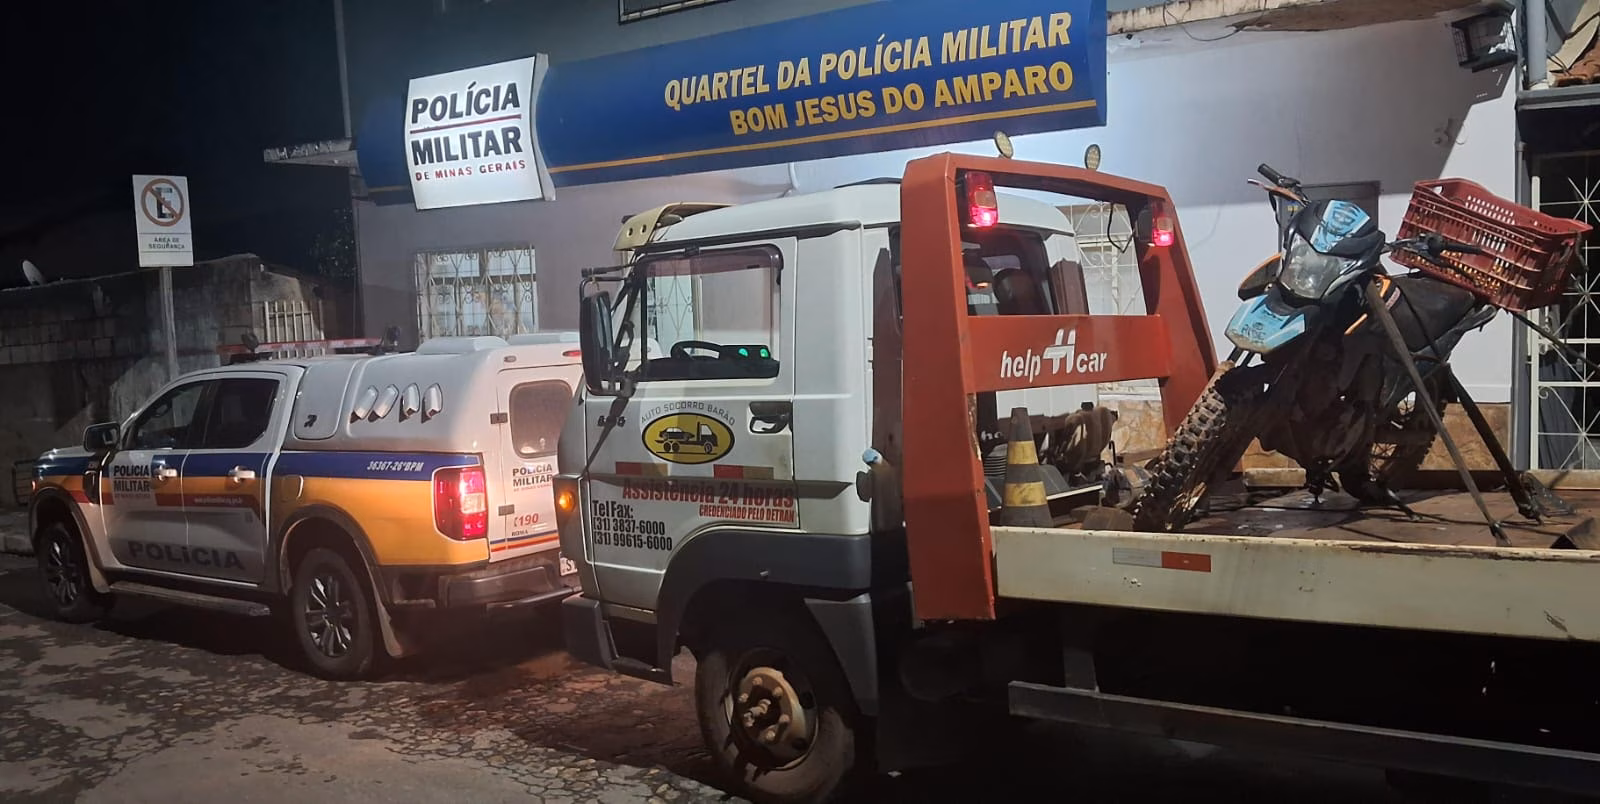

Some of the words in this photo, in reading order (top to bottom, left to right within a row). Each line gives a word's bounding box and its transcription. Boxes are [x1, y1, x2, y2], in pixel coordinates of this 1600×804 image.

[664, 64, 770, 110] QUARTEL
[777, 57, 811, 90] DA
[819, 33, 931, 84] POLÍCIA
[941, 11, 1072, 64] MILITAR
[411, 81, 520, 124] POLÍCIA
[729, 104, 788, 136] BOM
[794, 90, 876, 127] JESUS
[883, 82, 924, 114] DO
[934, 61, 1074, 108] AMPARO
[411, 126, 523, 166] MILITAR
[415, 171, 430, 181] DE
[435, 166, 472, 179] MINAS
[479, 159, 526, 174] GERAIS
[1000, 349, 1041, 383] help
[1076, 352, 1107, 373] car
[641, 406, 661, 423] AUTO
[663, 401, 704, 412] SOCORRO
[113, 480, 150, 492] MILITAR
[719, 481, 739, 505] 24
[742, 482, 794, 508] horas
[593, 516, 610, 531] (31)
[613, 518, 665, 535] 3837-6000
[698, 504, 747, 519] CREDENCIADO
[747, 507, 765, 521] PELO
[766, 508, 795, 523] DETRAN
[593, 531, 611, 545] (31)
[613, 533, 672, 551] 99615-6000
